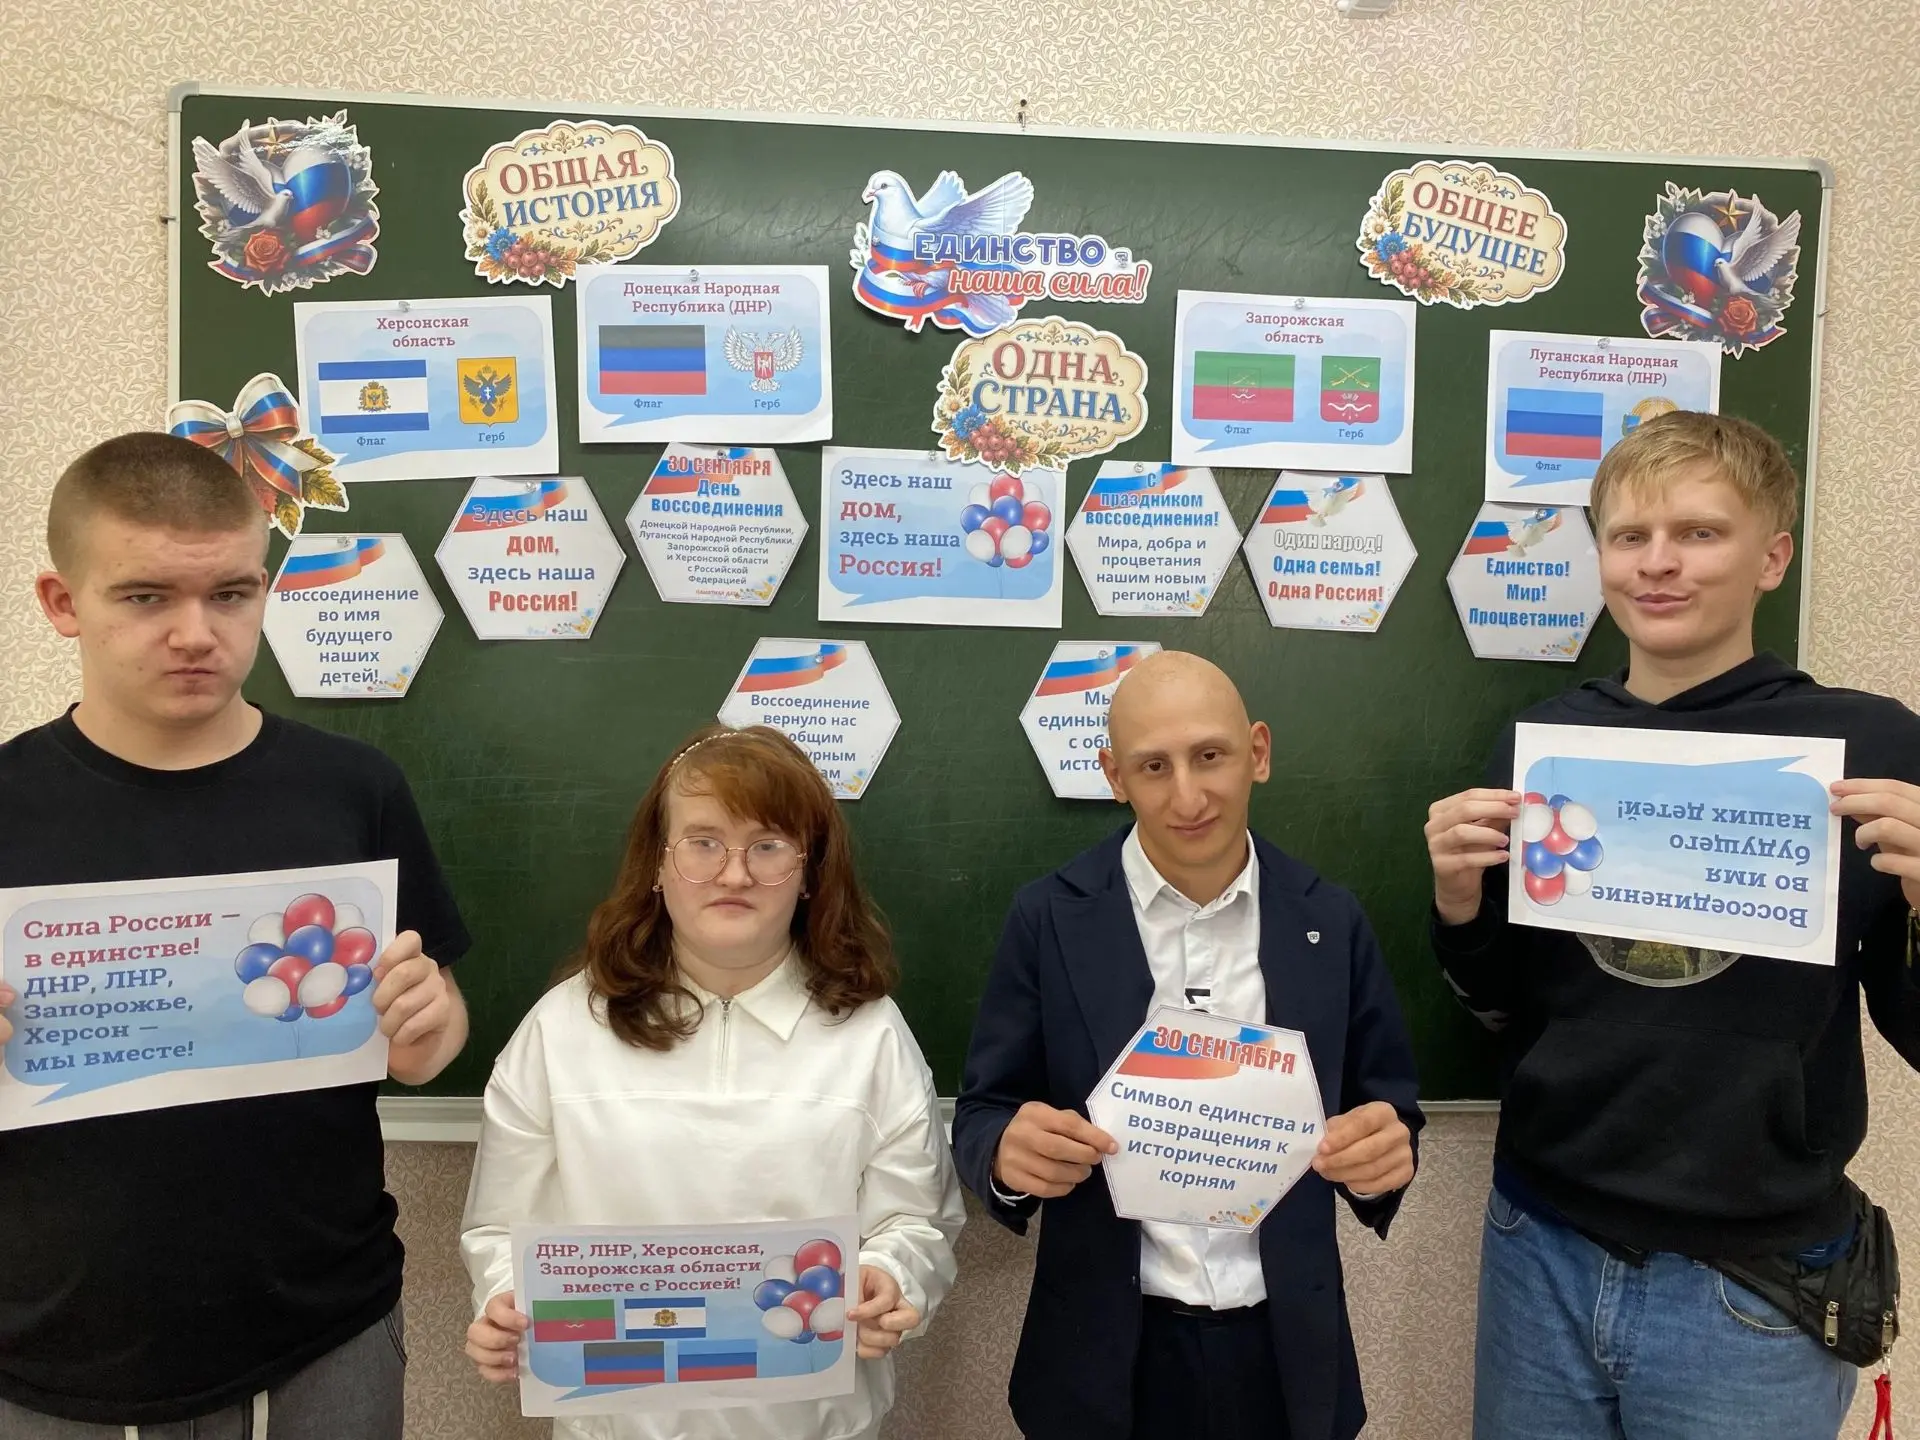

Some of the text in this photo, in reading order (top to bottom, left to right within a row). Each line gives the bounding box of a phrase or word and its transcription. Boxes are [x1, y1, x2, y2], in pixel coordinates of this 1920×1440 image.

[500, 149, 648, 196] ОБЩАЯ
[503, 181, 663, 228] ИСТОРИЯ
[1413, 181, 1541, 242] ОБЩЕЕ
[914, 233, 1105, 266] ЕДИНСТВО
[1402, 211, 1547, 277] БУДУЩЕЕ
[624, 282, 780, 296] Донецкая Народная
[949, 266, 1148, 299] наша сила!
[632, 300, 772, 315] Республика (ДНР)
[376, 316, 469, 332] Херсонская
[1245, 312, 1344, 329] Запорожская
[392, 334, 456, 348] область
[1265, 330, 1324, 345] область
[992, 340, 1124, 386] ОДНА
[1529, 349, 1678, 370] Луганская Народная
[1539, 367, 1667, 386] Республика (ЛНР)
[634, 399, 663, 409] Флаг
[754, 399, 780, 409] Герб
[972, 379, 1130, 424] СТРАНА
[478, 431, 505, 444] Герб
[1224, 425, 1252, 437] Флаг
[1338, 428, 1363, 440] Герб
[356, 435, 386, 448] Флаг
[668, 455, 771, 476] 30 СЕНТЯБРЯ
[1535, 461, 1562, 472] Флаг
[698, 480, 740, 496] День
[841, 470, 952, 490] Здесь наш
[1148, 473, 1156, 487] С
[652, 498, 783, 517] воссоединения
[1101, 493, 1203, 508] праздником
[472, 504, 588, 525] Здесь наш
[841, 501, 902, 522] дом,
[1086, 511, 1219, 528] воссоединения!
[640, 520, 794, 535] Донецкой Народной Республики,
[507, 536, 560, 556] дом,
[639, 531, 795, 545] Луганской Народной Республики,
[840, 531, 960, 547] здесь наша
[1098, 536, 1206, 552] Мира, добра и
[1274, 530, 1382, 552] Один народ!
[667, 543, 768, 554] Запорожской области
[676, 554, 729, 563] Херсонской
[732, 556, 768, 564] области
[839, 554, 941, 577] Россия!
[1102, 555, 1201, 569] процветания
[1273, 556, 1380, 577] Одна семья!
[1486, 558, 1569, 578] Единство!
[468, 566, 595, 583] здесь наша
[694, 565, 748, 574] Российской
[689, 575, 746, 585] Федерацией
[1097, 573, 1206, 585] нашим новым
[280, 588, 419, 604] Воссоединение
[1112, 589, 1190, 604] регионам!
[1269, 581, 1383, 602] Одна Россия!
[1507, 584, 1547, 603] Мир!
[489, 590, 577, 612] Россия!
[318, 609, 380, 622] во имя
[1469, 608, 1585, 629] Процветание!
[306, 628, 393, 646] будущего
[319, 650, 379, 663] наших
[320, 669, 379, 686] детей!
[751, 695, 870, 710] Воссоединение
[764, 714, 856, 727] вернуло нас
[1617, 800, 1812, 830] наших детей!
[1669, 834, 1811, 865] будущего
[1705, 868, 1809, 892] во имя
[1592, 886, 1808, 929] Воссоединение
[24, 920, 100, 940] Сила
[108, 913, 213, 934] России
[25, 937, 200, 967] в единстве!
[25, 967, 173, 999] ДНР, ЛНР,
[24, 997, 193, 1021] Запорожье,
[24, 1023, 129, 1048] Херсон
[24, 1042, 194, 1073] мы вместе!
[1154, 1026, 1296, 1075] 30 СЕНТЯБРЯ
[1111, 1081, 1315, 1134] Символ единства и
[1128, 1114, 1289, 1154] возвращения к
[1128, 1139, 1277, 1175] историческим
[1159, 1169, 1235, 1191] корням
[536, 1243, 764, 1260] ДНР, ЛНР, Херсонская,
[540, 1260, 761, 1277] Запорожская области
[563, 1278, 741, 1293] вместе с Россией!
